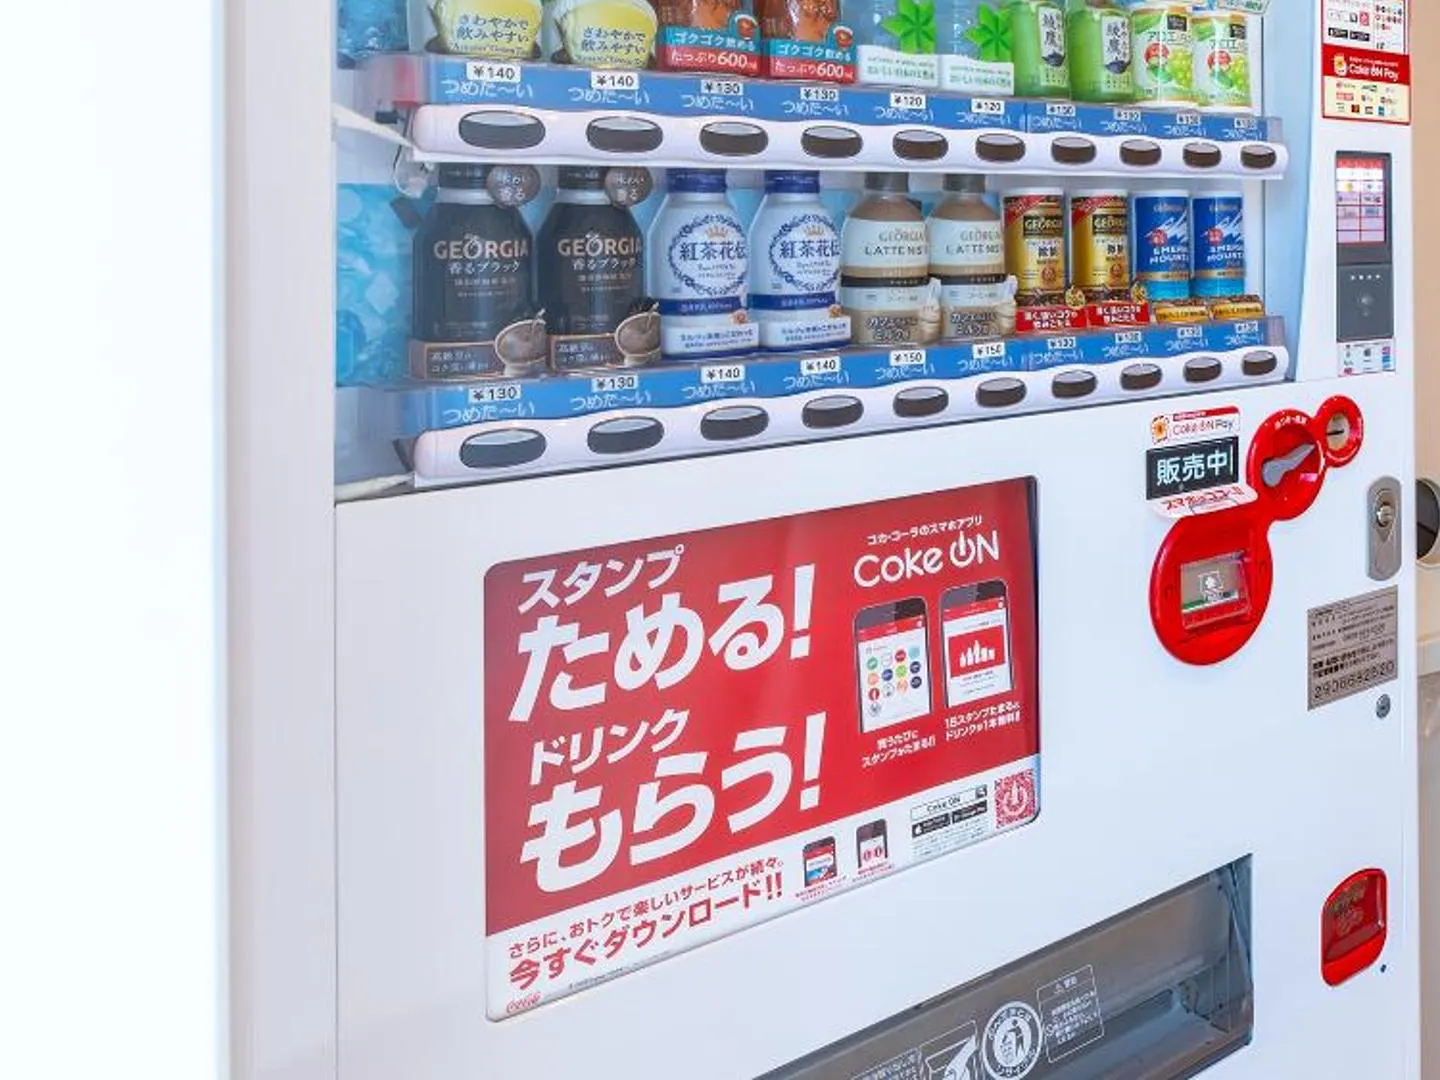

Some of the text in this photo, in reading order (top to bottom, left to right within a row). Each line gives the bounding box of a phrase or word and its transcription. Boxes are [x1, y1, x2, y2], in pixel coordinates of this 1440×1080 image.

[473, 65, 515, 81] ¥140
[596, 74, 635, 87] ¥140
[433, 232, 529, 259] GEORGIA
[1156, 448, 1229, 487] 販売中
[866, 514, 983, 547] コカ・コーラのスマホアプリ
[853, 530, 1000, 588] Coke ON
[517, 544, 685, 614] スタンプ
[530, 708, 690, 786] ドリンク
